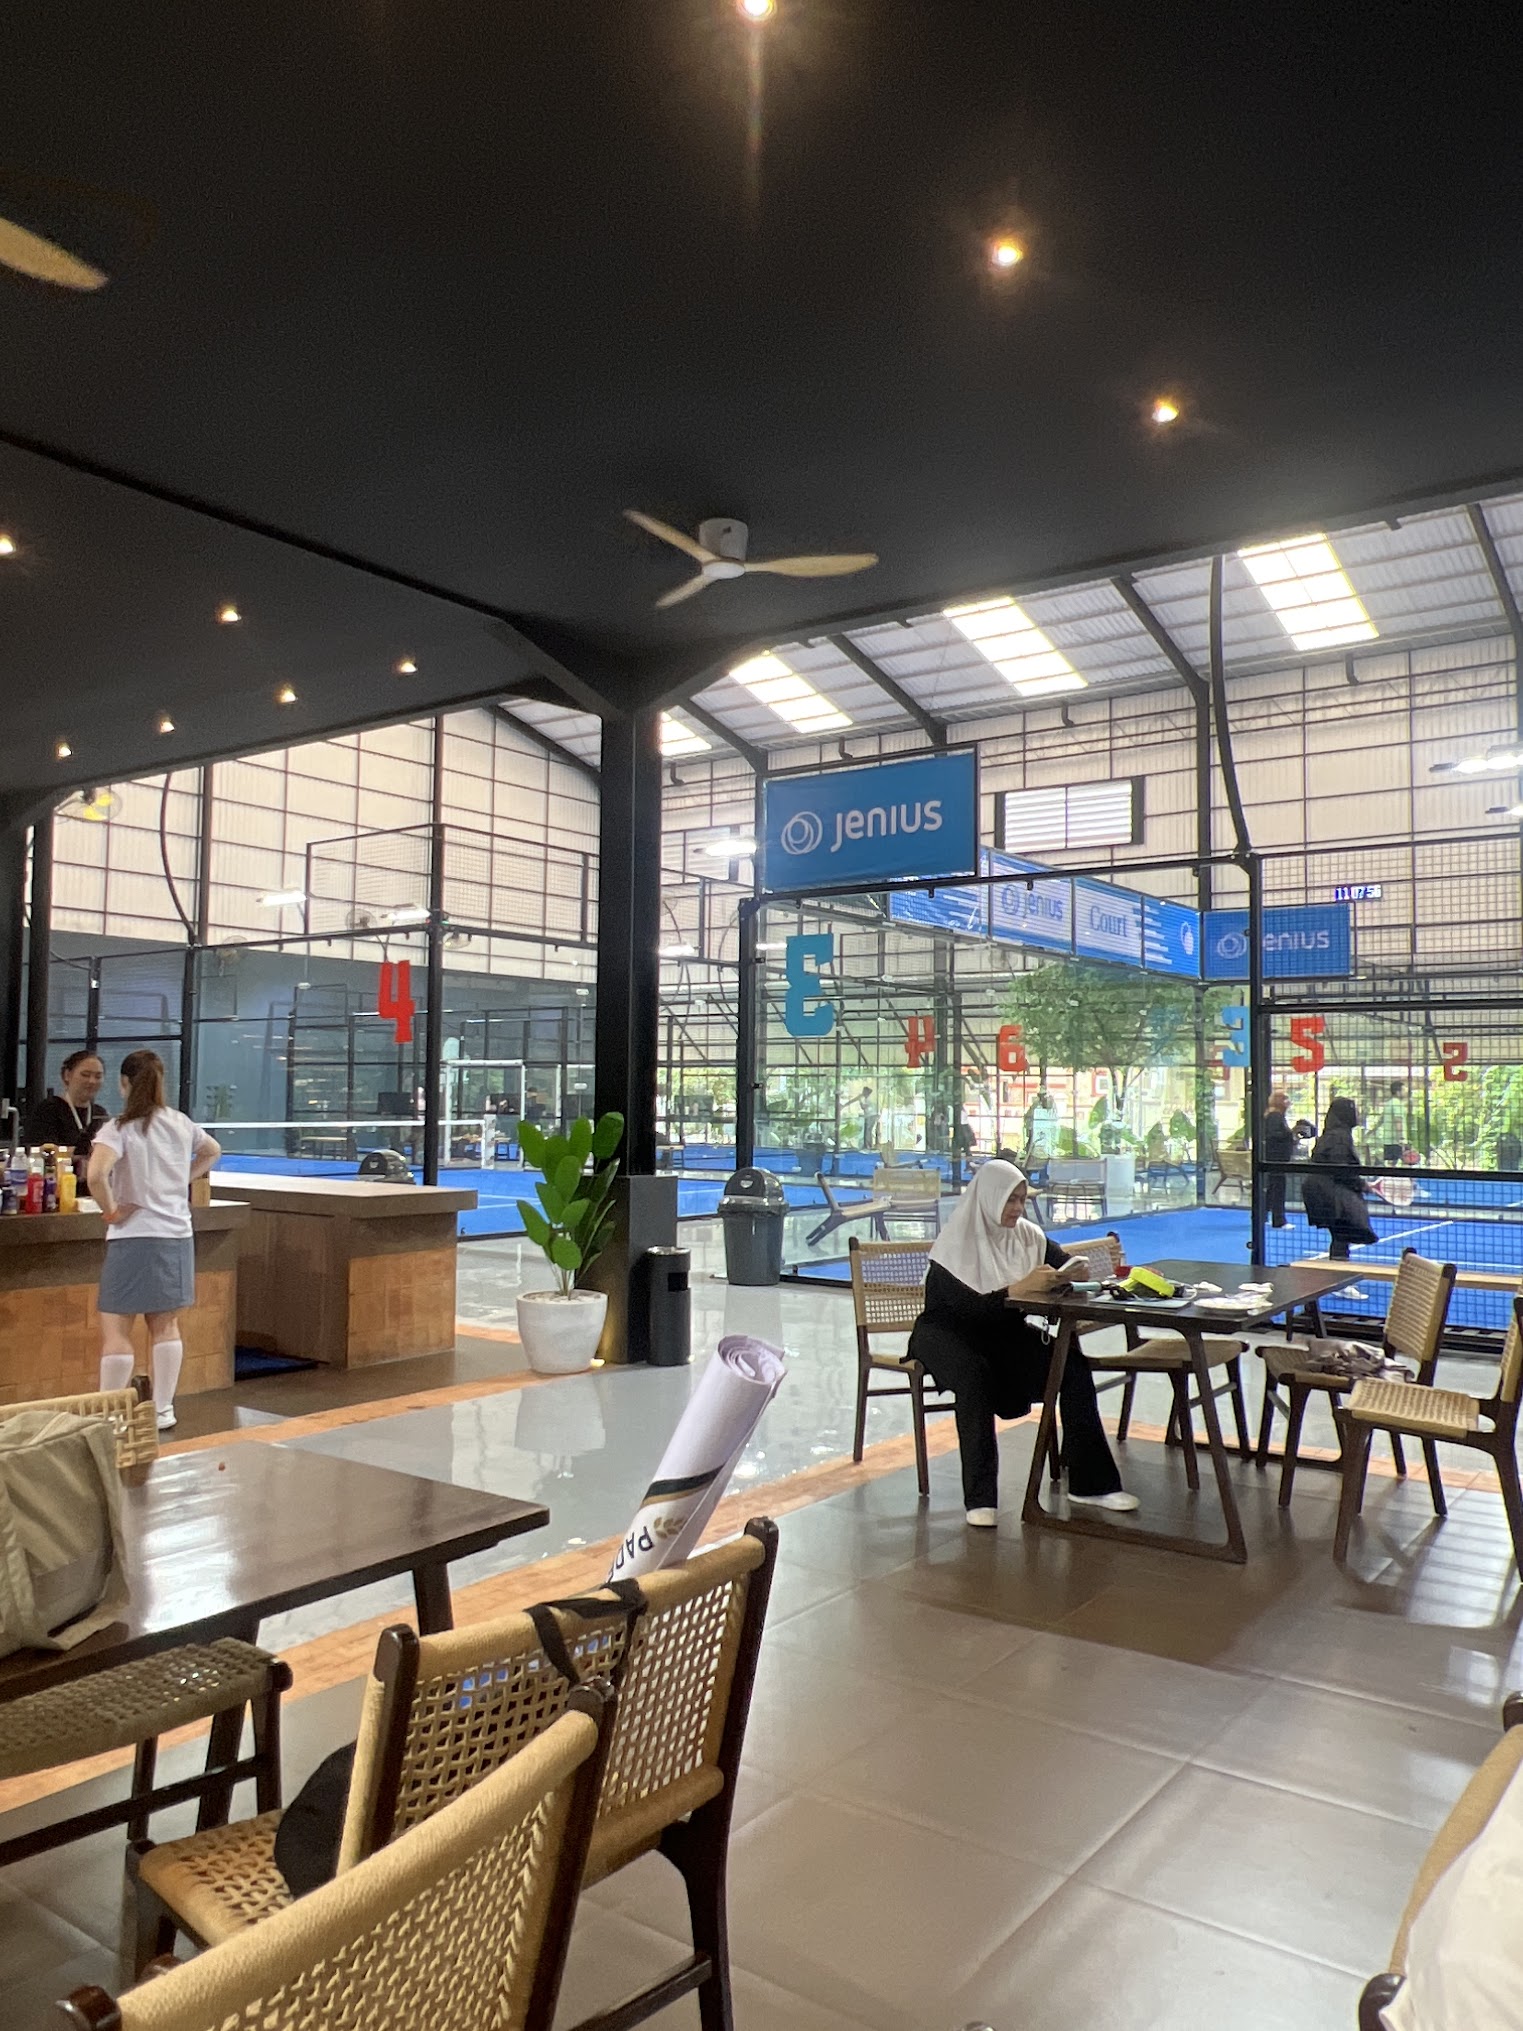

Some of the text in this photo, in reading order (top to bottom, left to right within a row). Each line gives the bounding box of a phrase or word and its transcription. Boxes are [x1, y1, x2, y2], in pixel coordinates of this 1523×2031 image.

[1089, 905, 1128, 938] Court
[378, 960, 415, 1043] 4
[997, 1024, 1026, 1072] 6
